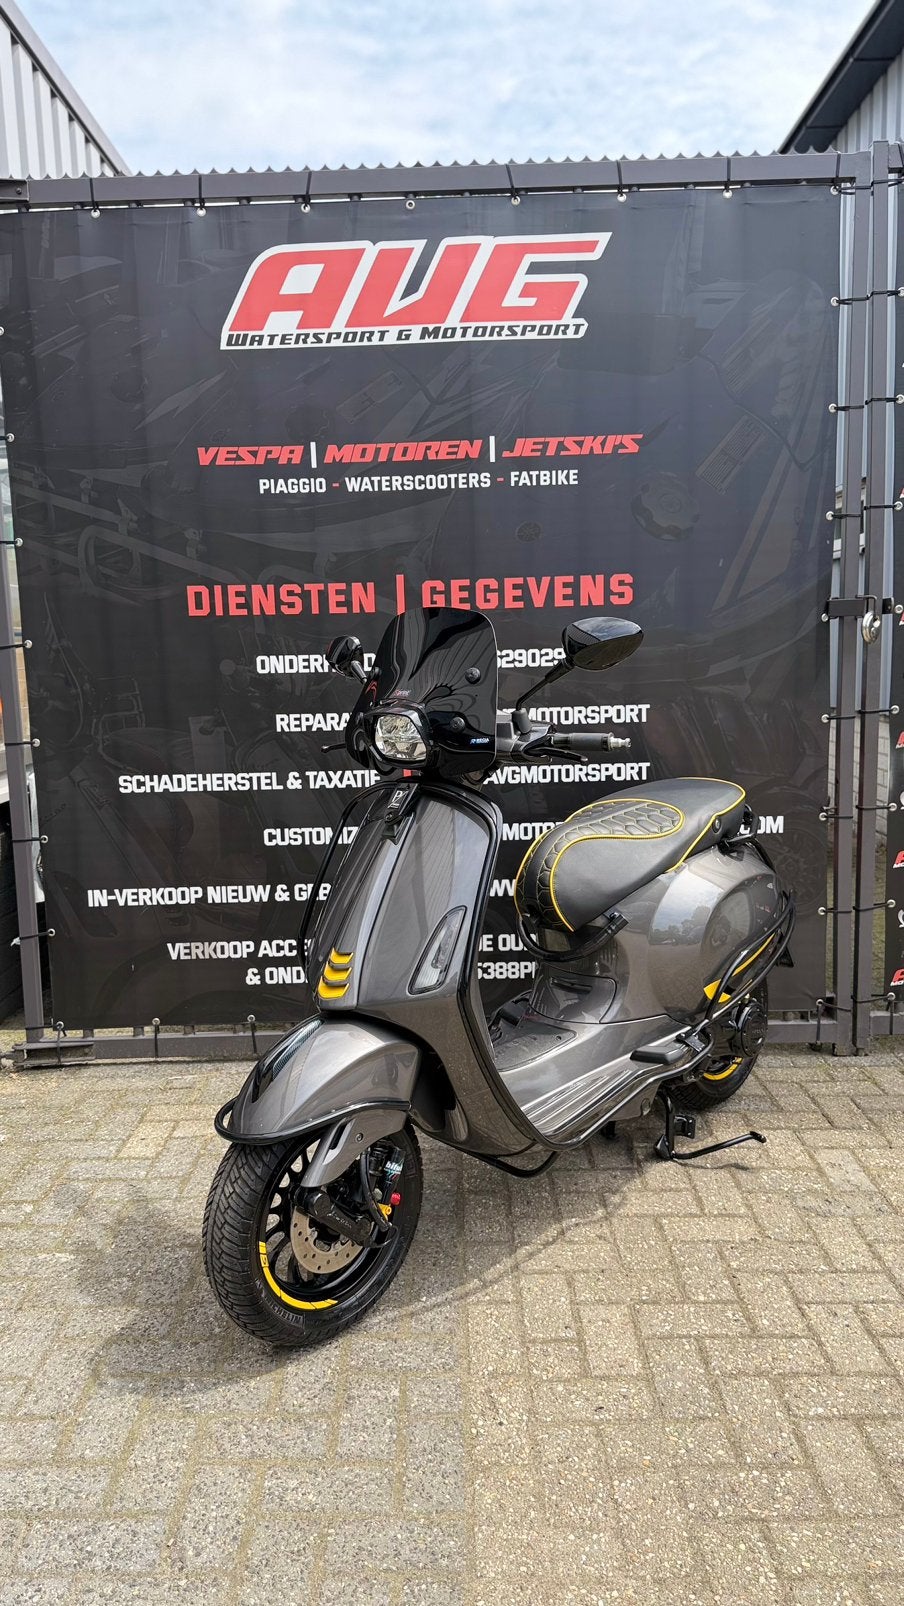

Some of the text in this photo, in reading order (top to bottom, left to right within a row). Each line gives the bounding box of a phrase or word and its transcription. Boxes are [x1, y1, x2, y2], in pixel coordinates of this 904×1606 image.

[219, 231, 614, 331] AVG
[197, 445, 305, 467] VESPA
[324, 439, 483, 465] MOTOREN
[503, 434, 643, 459] JETSKI'S
[258, 477, 327, 495] PIAGGIO
[344, 472, 491, 493] WATERSCOOTERS
[510, 469, 579, 487] FATBIKE
[186, 581, 377, 617] DIENSTEN
[421, 573, 634, 611] GEGEVENS
[118, 771, 284, 794] SCHADEHERSTEL
[286, 771, 303, 790] &
[87, 886, 203, 908] IN-VERKOOP
[206, 884, 271, 904] NIEUW
[274, 884, 291, 902] &
[166, 940, 255, 961] VERKOOP
[245, 967, 261, 986] &
